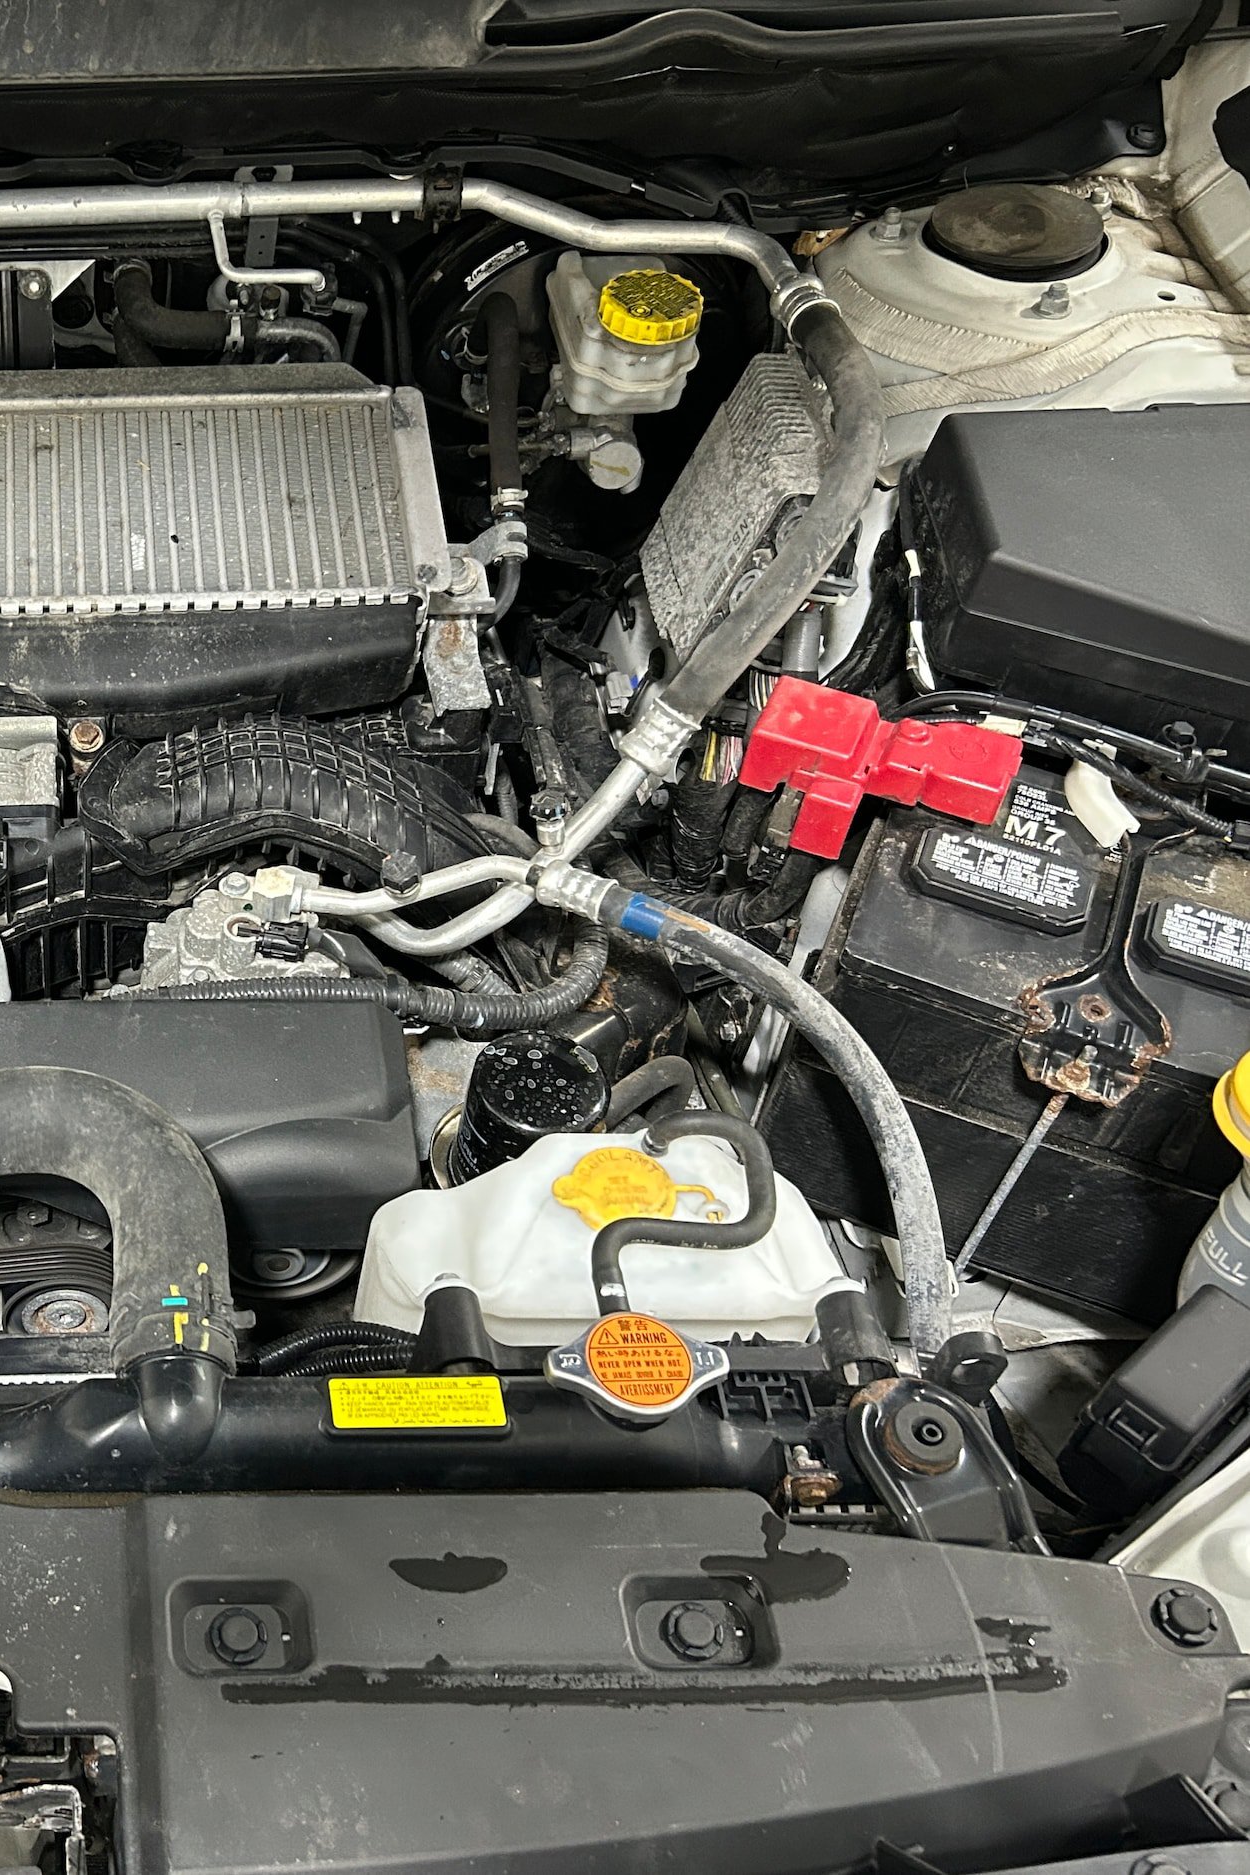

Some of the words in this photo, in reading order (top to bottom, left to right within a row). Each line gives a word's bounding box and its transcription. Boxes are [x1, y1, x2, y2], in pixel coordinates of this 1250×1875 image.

[1010, 808, 1044, 822] GROUP
[1004, 814, 1040, 842] M
[1044, 824, 1067, 847] 7
[1206, 1225, 1249, 1280] FULL
[617, 1319, 648, 1331] 警告
[620, 1332, 668, 1345] WARNING
[598, 1360, 620, 1369] NEVER
[623, 1359, 642, 1368] OPEN
[644, 1359, 664, 1368] WHEN
[415, 1380, 458, 1388] ATTENTION
